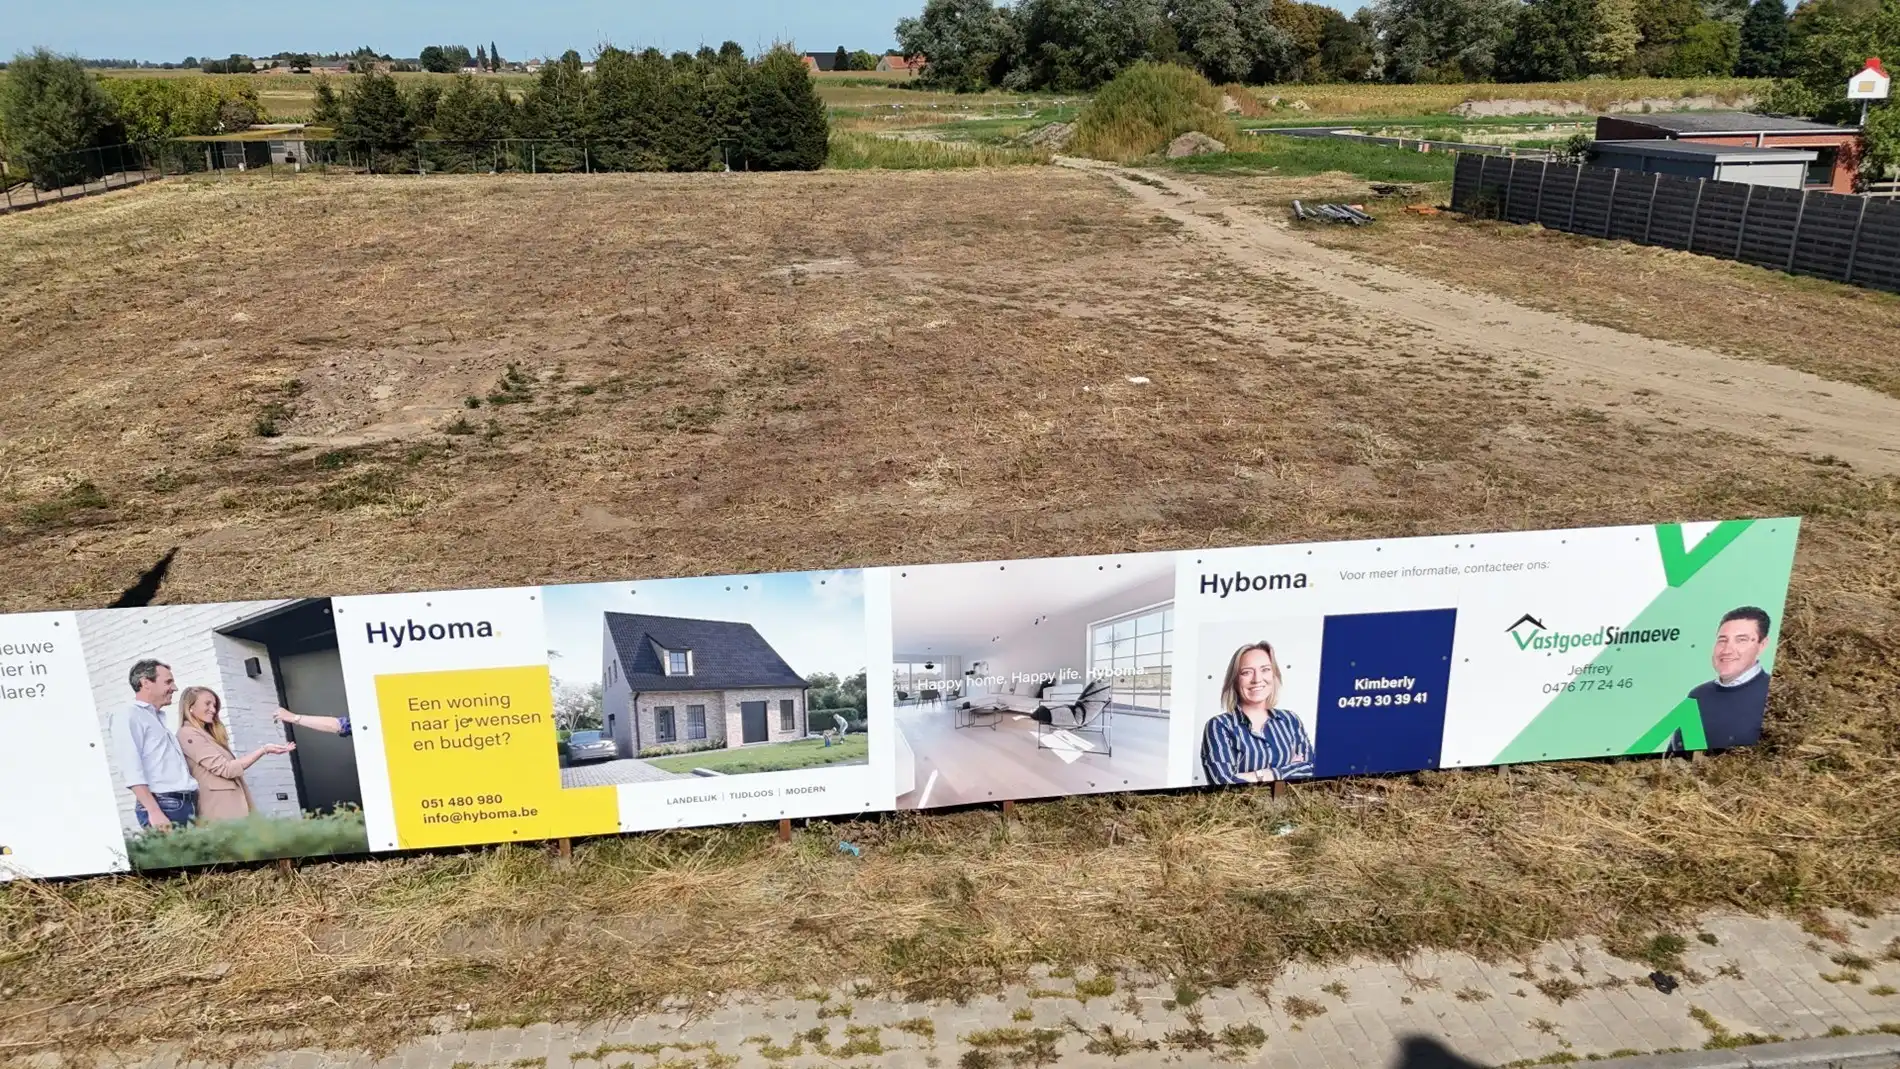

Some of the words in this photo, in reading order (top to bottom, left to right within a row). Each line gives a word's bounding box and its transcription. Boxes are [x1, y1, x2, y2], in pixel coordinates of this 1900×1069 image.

[1338, 570, 1365, 581] Voor
[1368, 568, 1398, 579] meer
[1401, 564, 1461, 577] informatie,
[1463, 561, 1524, 574] contacteer
[1526, 560, 1551, 571] ons:
[29, 660, 47, 675] in
[1567, 663, 1614, 676] Jeffrey
[917, 677, 962, 693] Happy
[966, 673, 1007, 686] home.
[1011, 670, 1056, 686] Happy
[1058, 667, 1082, 681] life.
[1086, 664, 1149, 681] Hyboma.
[1354, 675, 1416, 690] Kimberly
[1542, 681, 1576, 694] 0476
[1579, 680, 1595, 692] 77
[1597, 679, 1613, 691] 24
[1616, 677, 1633, 689] 46
[408, 696, 441, 711] Een
[446, 692, 511, 709] woning
[1338, 695, 1372, 708] 0479
[1374, 694, 1392, 706] 30
[1394, 693, 1411, 705] 39
[1413, 691, 1428, 703] 41
[411, 717, 449, 731] naar
[454, 714, 472, 732] je
[474, 712, 541, 727] wensen
[413, 739, 435, 751] en
[440, 732, 511, 750] budget?
[421, 798, 444, 809] 051
[448, 796, 474, 807] 480
[477, 794, 503, 805] 980
[666, 793, 718, 806] LANDELIJK
[729, 789, 774, 801] TIJDLOOS
[785, 785, 826, 796] MODERN
[423, 806, 538, 824] info@hyboma.be
